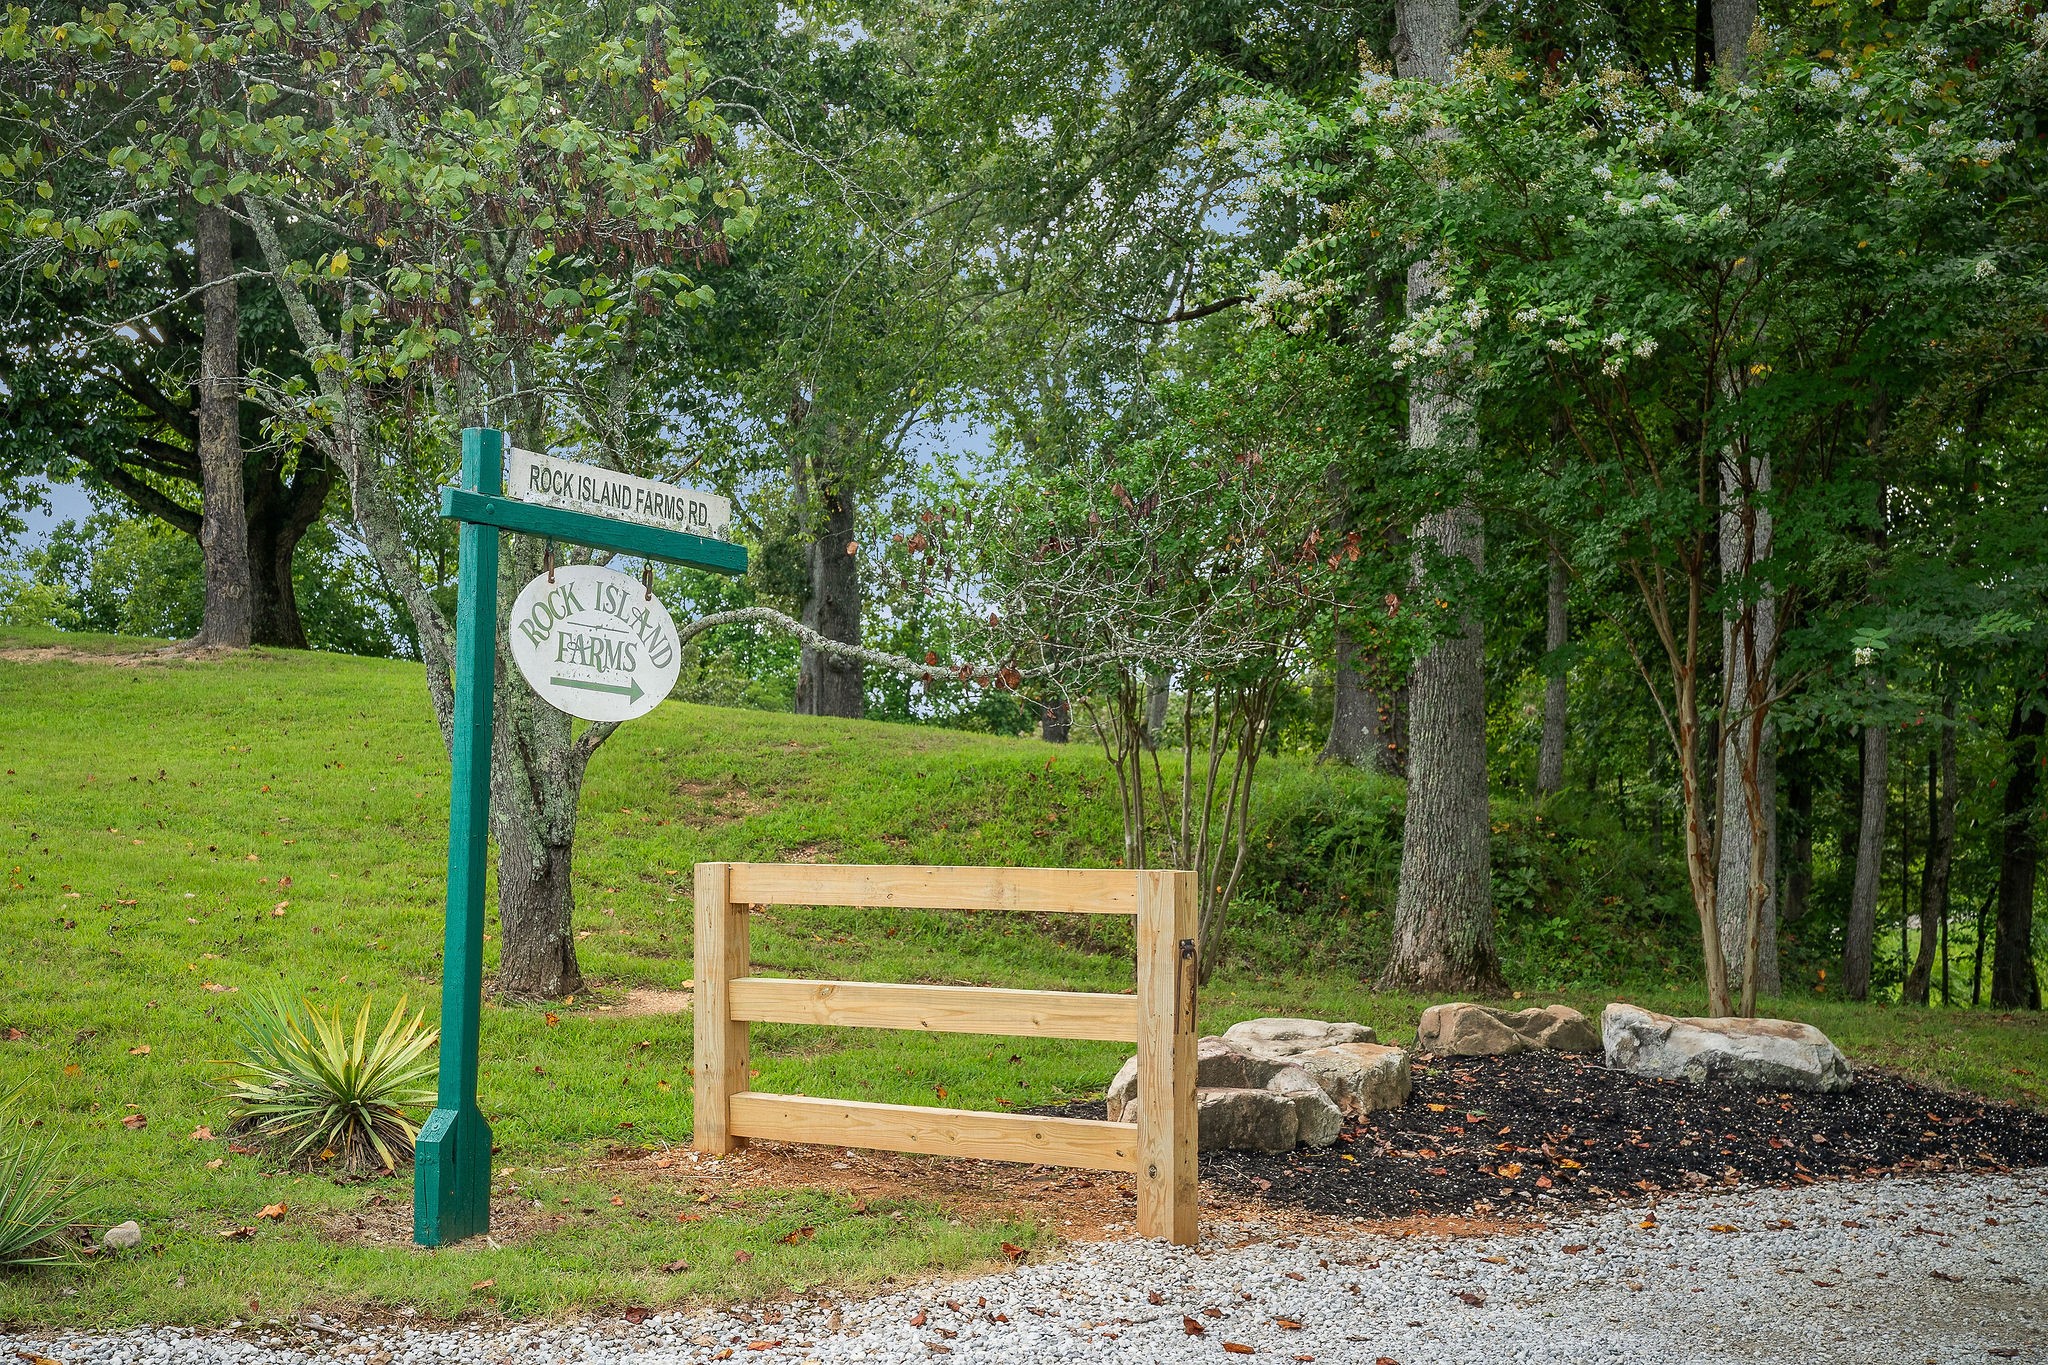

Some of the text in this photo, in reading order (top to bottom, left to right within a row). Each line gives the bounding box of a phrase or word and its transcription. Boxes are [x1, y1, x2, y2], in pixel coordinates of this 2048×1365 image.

[529, 464, 711, 527] ROCK ISLAND FARMS RD.
[517, 580, 673, 669] ROCK ISLAND
[554, 630, 638, 674] FARMS
